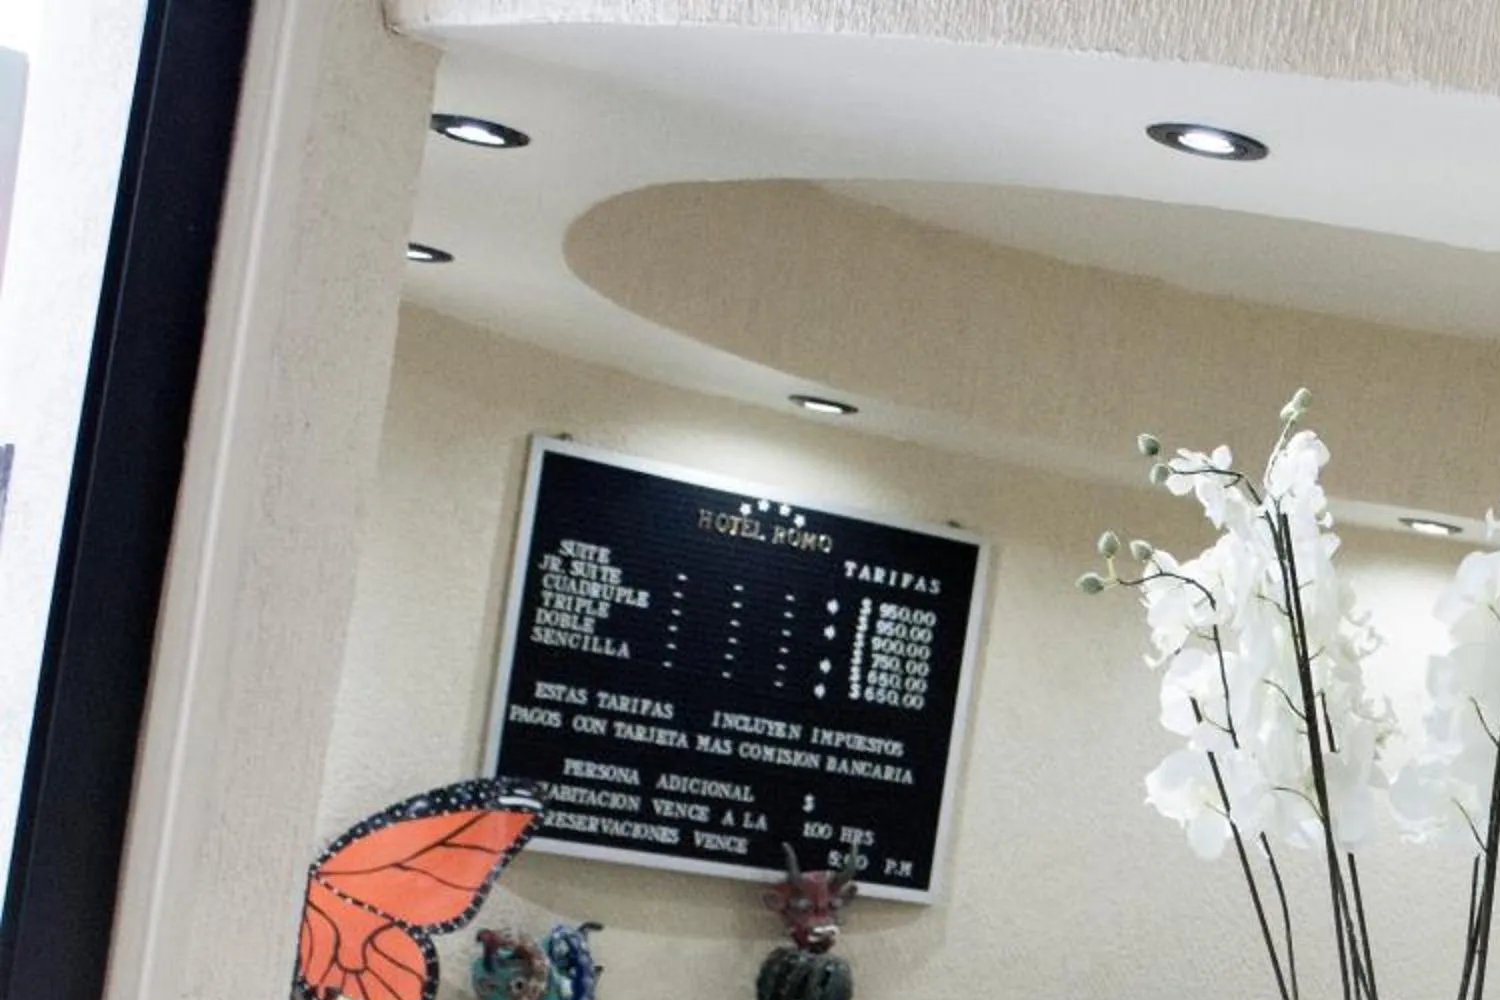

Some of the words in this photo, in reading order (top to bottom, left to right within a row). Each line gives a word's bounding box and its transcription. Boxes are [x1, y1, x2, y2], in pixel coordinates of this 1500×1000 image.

[698, 508, 765, 541] HOTEL
[773, 526, 833, 553] ROMO
[559, 539, 611, 563] SUITE
[569, 560, 623, 585] SUITE
[845, 560, 941, 595] TARIFAS
[541, 590, 611, 618] TRIPLE
[542, 573, 650, 608] CUADRUPLE
[535, 607, 596, 634] DOBLE
[530, 626, 631, 660] SENCILLA
[535, 681, 589, 705] ESTAS
[597, 691, 674, 719] TARIFAS
[711, 710, 803, 740] INCLUYEN
[810, 727, 904, 757] IMPUESTOS
[509, 704, 562, 728] PAGOS
[572, 714, 609, 735] CON
[613, 720, 689, 749] TARJETA
[696, 735, 732, 756] MAS
[738, 741, 821, 769] COMISION
[825, 755, 914, 785] BANCARIA
[563, 758, 641, 786] PERSONA
[655, 773, 755, 803] ADICIONAL
[544, 810, 681, 844] RESERVACIONES
[693, 830, 749, 855] VENCE
[652, 798, 710, 823] VENCE
[721, 810, 735, 827] A
[742, 813, 768, 831] LA
[840, 825, 875, 846] HRS
